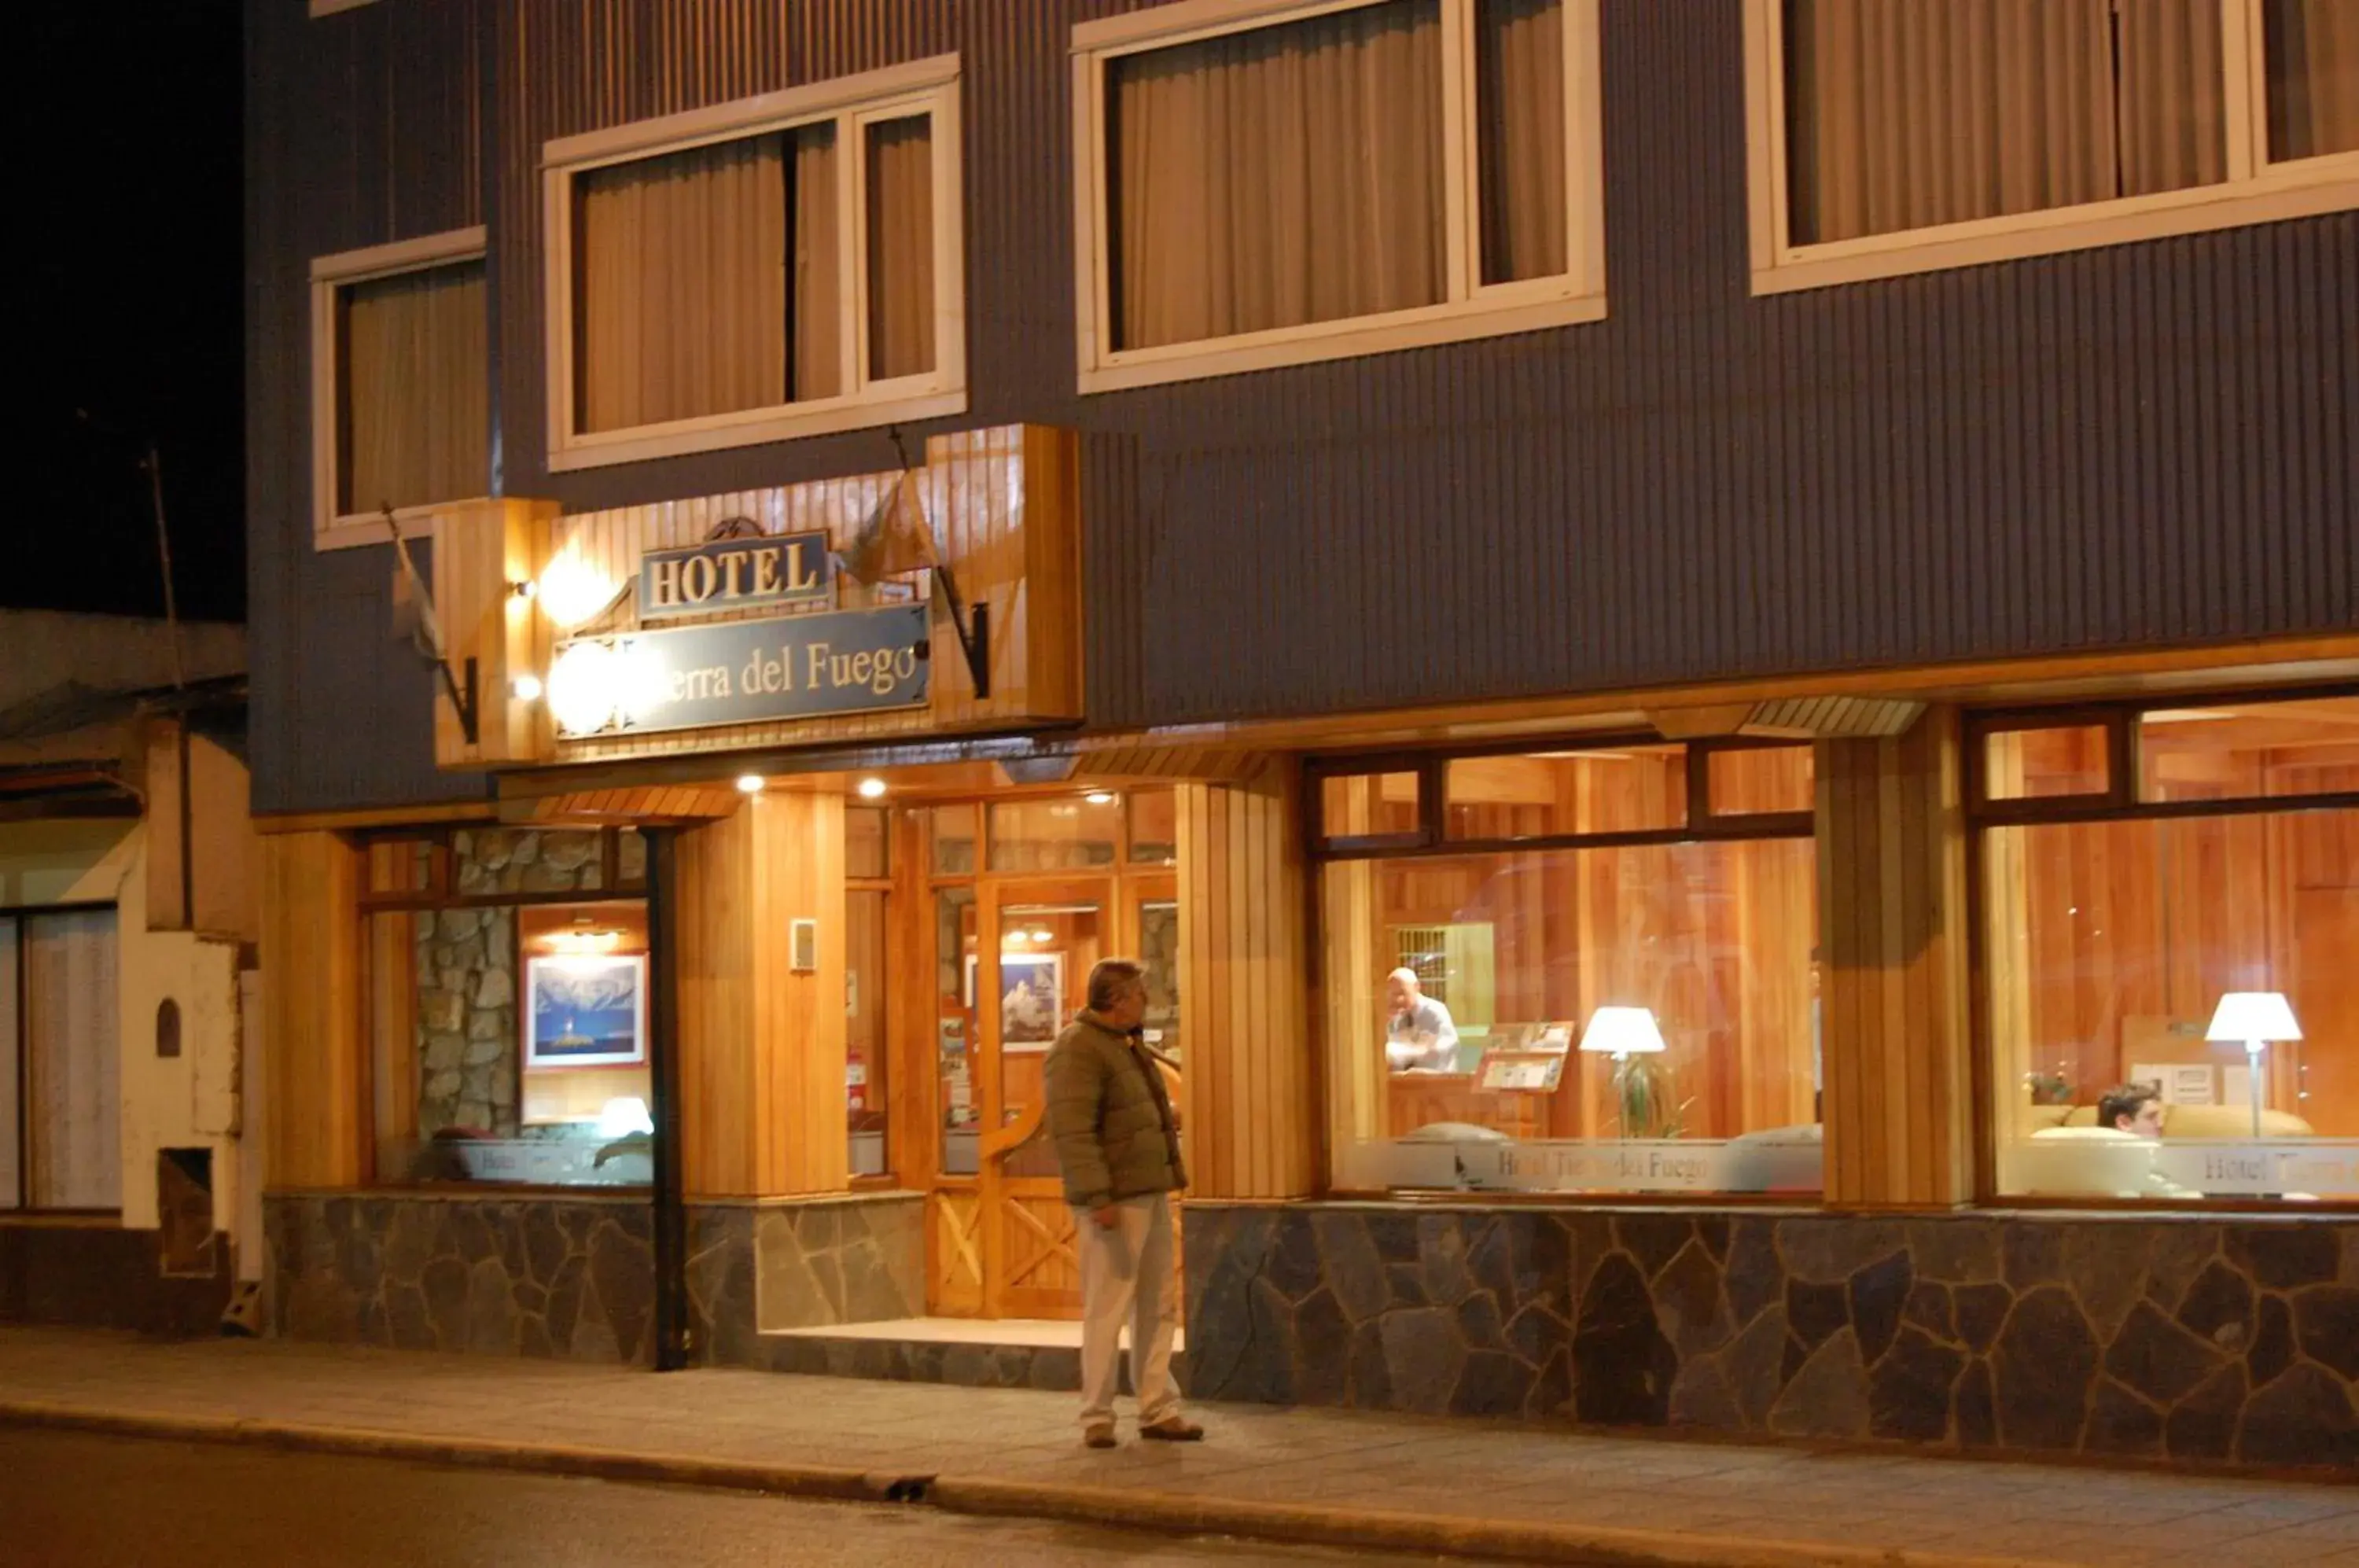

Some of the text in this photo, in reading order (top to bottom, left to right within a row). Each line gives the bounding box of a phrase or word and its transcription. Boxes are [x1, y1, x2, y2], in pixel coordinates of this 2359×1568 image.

[649, 543, 818, 609] HOTEL
[665, 642, 916, 702] erra del Fuego
